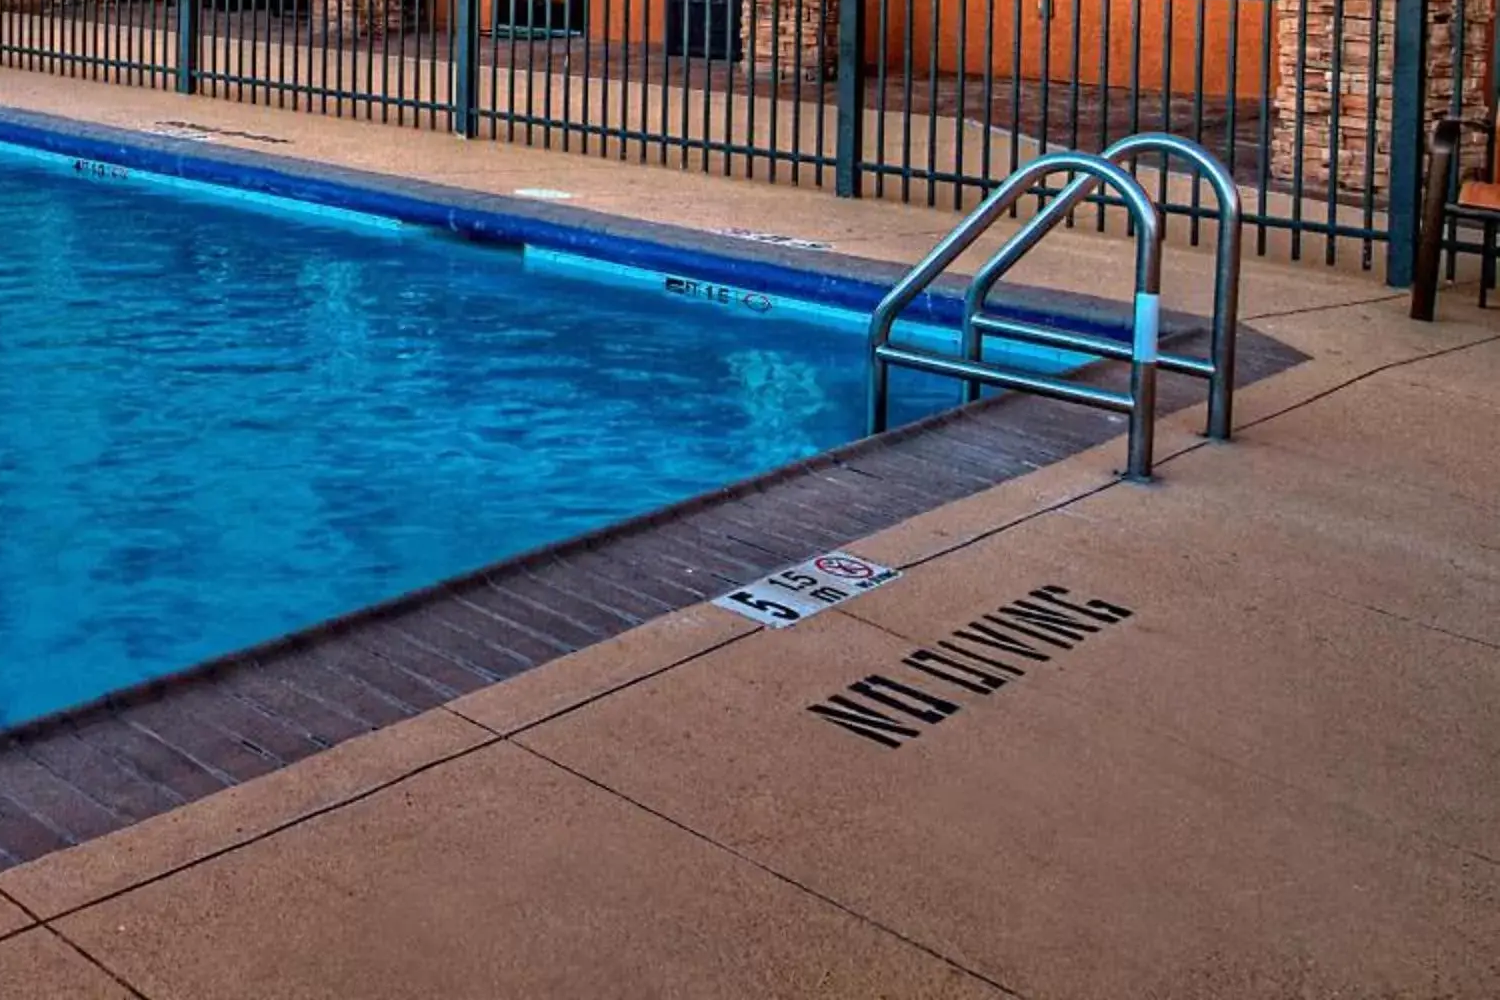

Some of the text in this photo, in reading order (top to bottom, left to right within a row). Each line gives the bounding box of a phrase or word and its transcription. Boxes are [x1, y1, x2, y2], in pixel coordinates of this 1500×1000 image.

[728, 591, 800, 621] 5
[805, 584, 1134, 749] NO DIVING
